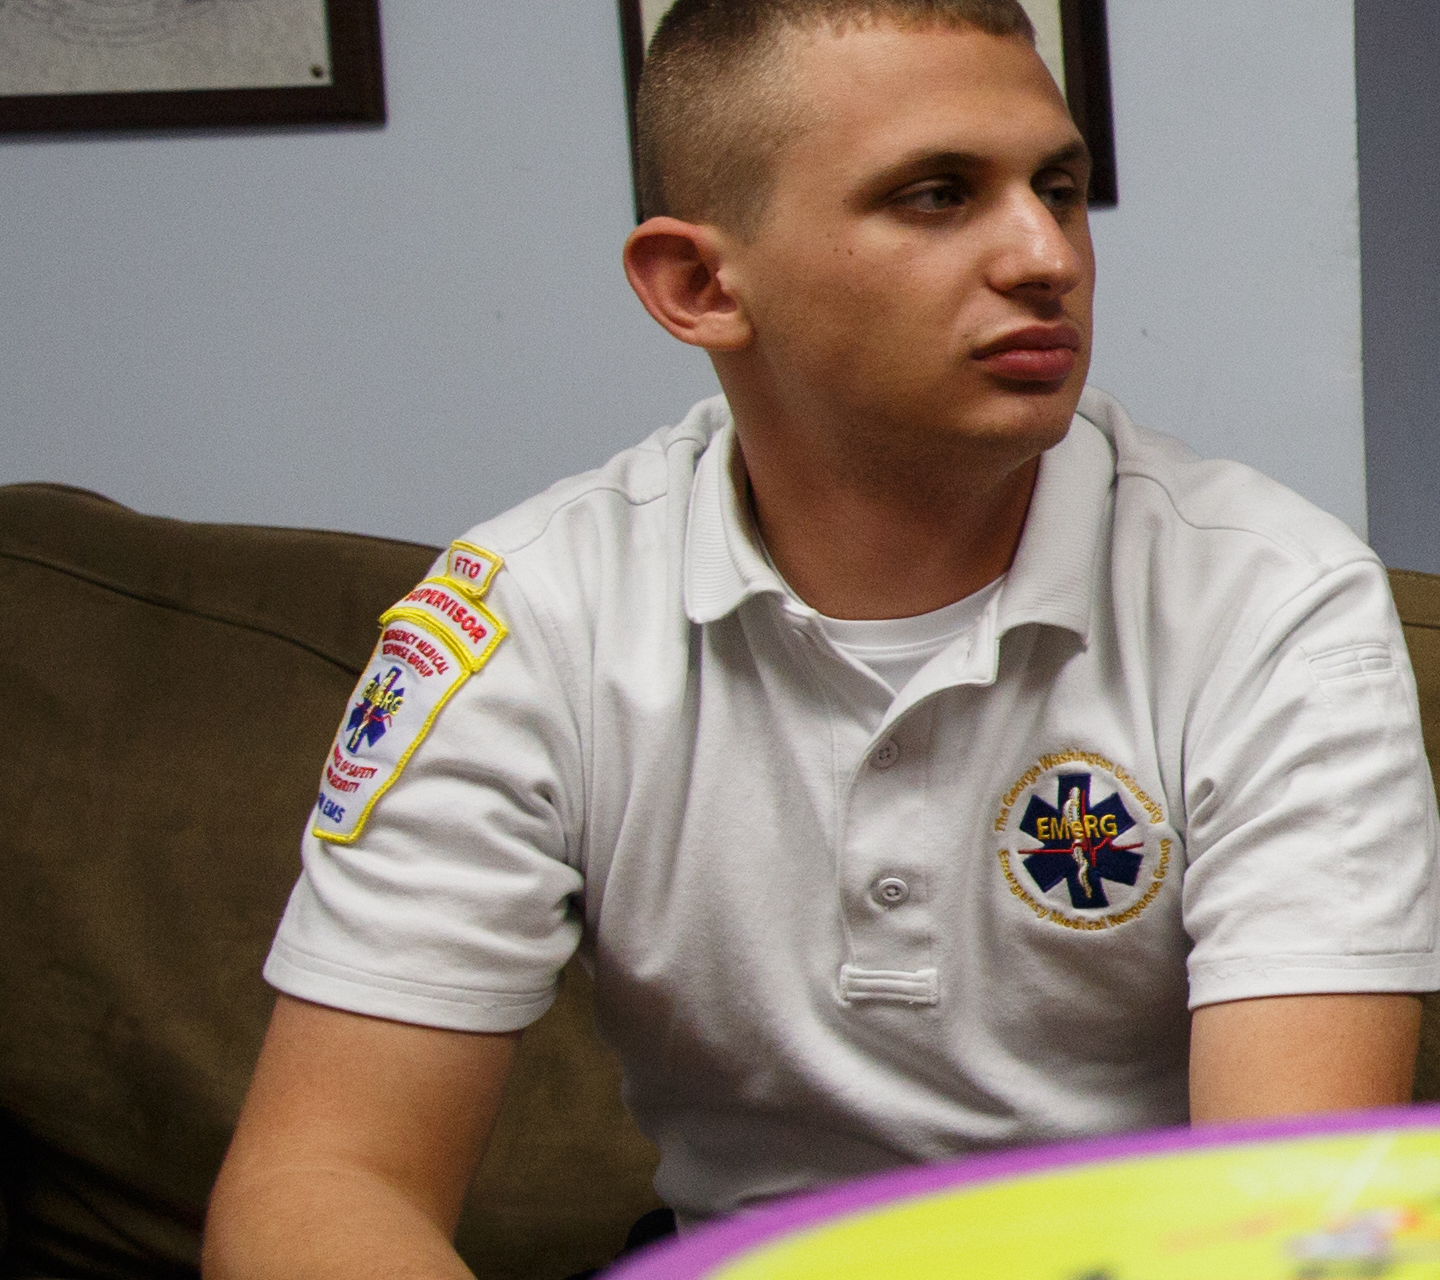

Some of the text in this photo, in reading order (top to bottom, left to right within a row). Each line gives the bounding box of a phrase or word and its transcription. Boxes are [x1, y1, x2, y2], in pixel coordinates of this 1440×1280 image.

[453, 555, 482, 580] FTO
[404, 587, 489, 646] SUPERVISOR
[406, 651, 435, 678] GROUP
[415, 639, 450, 676] MEDICAL
[993, 749, 1166, 834] The George Washington University
[322, 798, 346, 825] EMS
[1036, 813, 1119, 841] EMeRG
[997, 837, 1174, 931] Emergency Medical Response Group
